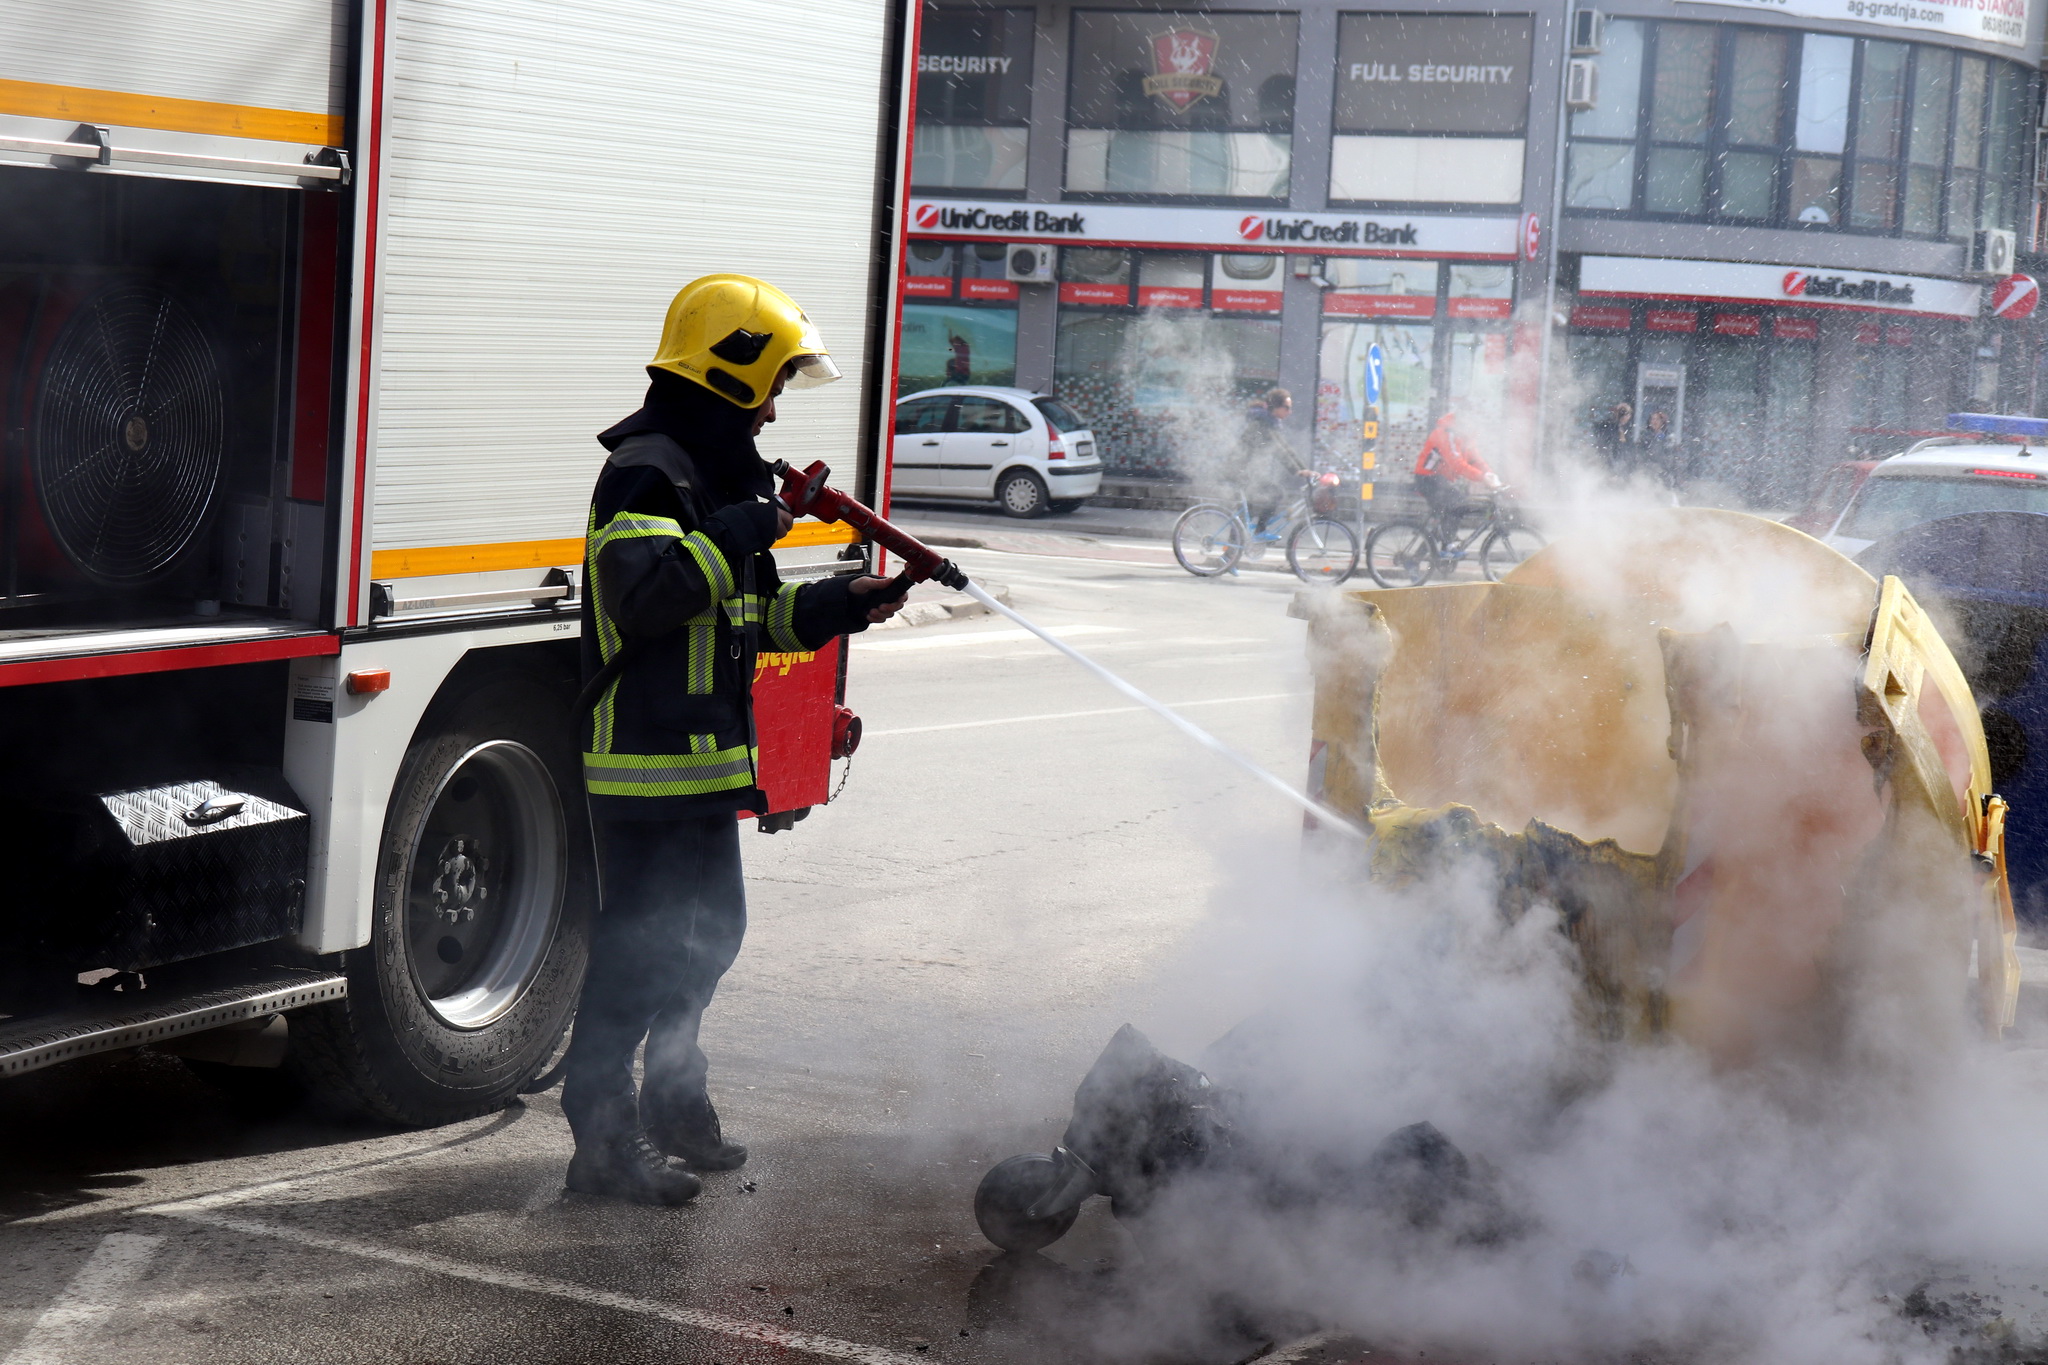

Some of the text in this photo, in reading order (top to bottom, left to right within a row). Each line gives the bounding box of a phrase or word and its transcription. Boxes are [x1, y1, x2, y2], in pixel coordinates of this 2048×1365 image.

[1847, 1, 1944, 23] ag-gradnja.com
[918, 55, 1012, 74] SECURITY
[1350, 64, 1513, 83] FULL SECURITY
[941, 207, 1085, 233] UniCredit Bank
[1266, 218, 1418, 245] UniCredit Bank
[563, 623, 571, 631] bar
